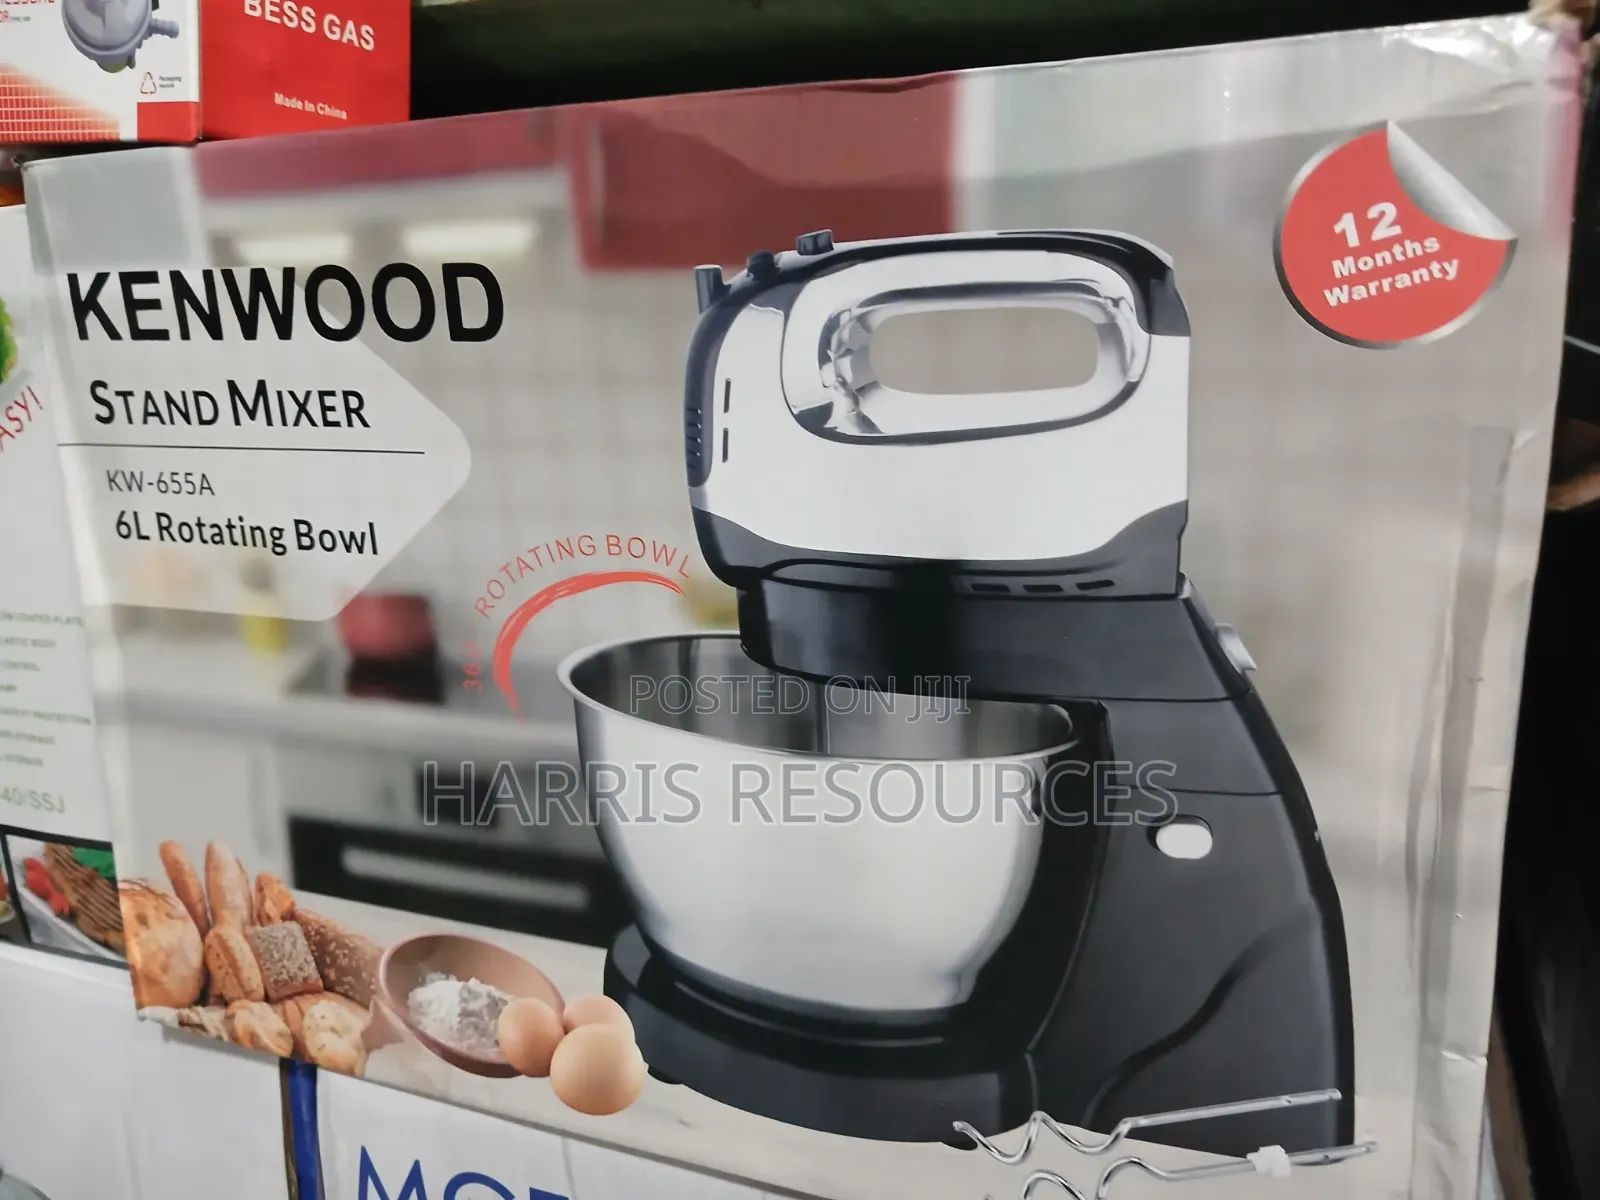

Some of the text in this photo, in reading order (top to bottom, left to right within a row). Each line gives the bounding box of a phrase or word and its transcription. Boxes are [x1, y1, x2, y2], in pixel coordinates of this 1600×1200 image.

[244, 0, 375, 51] BESS GAS
[274, 92, 303, 110] Made
[316, 103, 348, 120] China
[1333, 202, 1402, 248] 12
[1332, 237, 1440, 279] Months
[67, 262, 504, 342] KENWOOD
[1323, 259, 1459, 307] Warranty
[105, 470, 216, 497] KW-655A
[115, 510, 379, 556] 6L Rotating Bowl
[474, 534, 597, 620] ROTATING
[605, 534, 690, 580] BOWL
